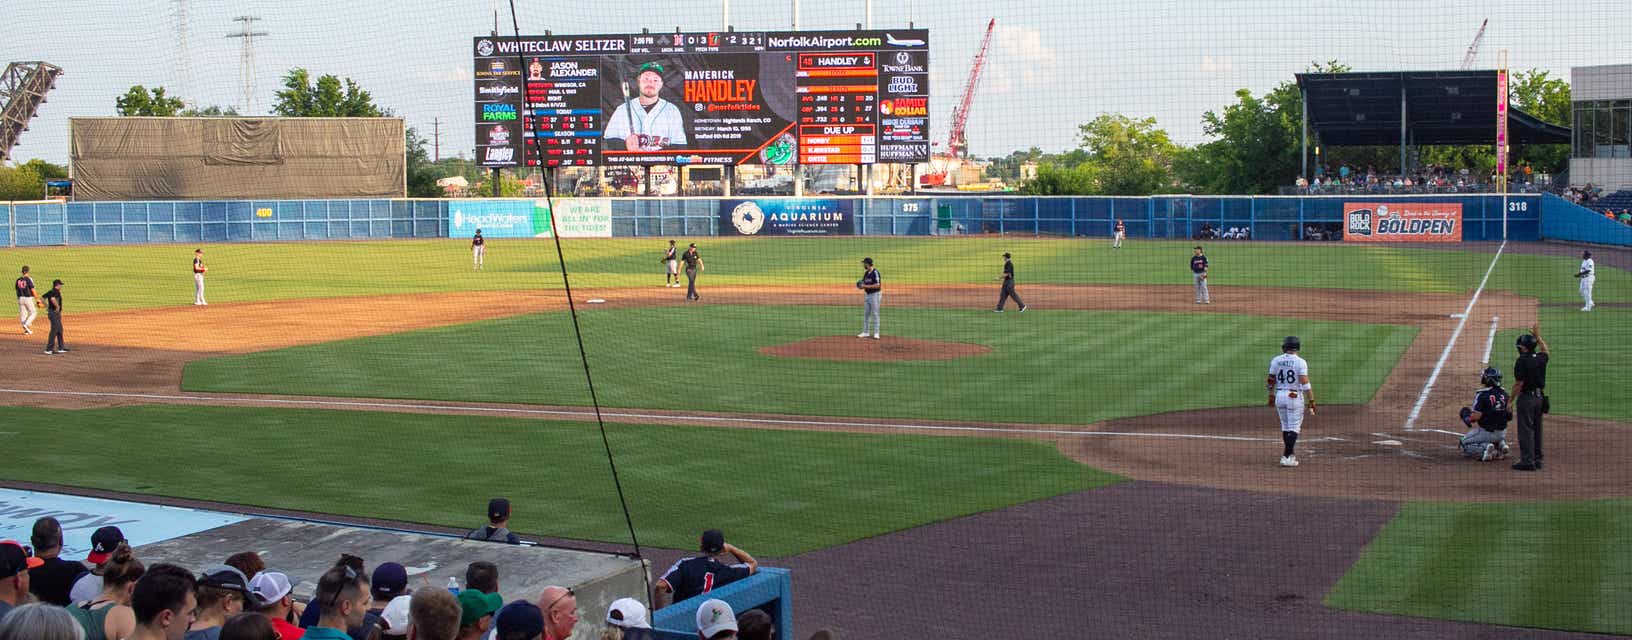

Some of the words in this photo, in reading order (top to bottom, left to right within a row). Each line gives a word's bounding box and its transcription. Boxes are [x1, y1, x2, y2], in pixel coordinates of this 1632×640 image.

[688, 36, 695, 45] 0
[700, 36, 707, 45] 3
[730, 35, 737, 44] 2
[768, 35, 881, 48] NorfolkAirport.com
[497, 40, 572, 52] WHITECLAW
[575, 39, 626, 51] SELTZER
[818, 57, 858, 65] HANDLEY
[684, 70, 735, 80] MAVERICK
[479, 86, 519, 95] Smithfield
[684, 80, 756, 102] HANDLEY
[888, 84, 918, 92] LIGHT
[893, 98, 927, 107] FAMILY
[483, 104, 517, 112] ROYAL
[707, 104, 761, 112] @norfolktides
[894, 106, 927, 115] DOLLAR
[483, 112, 517, 120] FARMS
[485, 146, 514, 161] Langley
[902, 203, 918, 212] 375
[1508, 202, 1527, 212] 318
[463, 212, 528, 224] HeadWaters
[770, 212, 843, 221] AQUARIUM
[1350, 214, 1369, 223] BOLD
[1350, 222, 1370, 230] ROCK
[1376, 218, 1455, 235] BOLDPEN
[1277, 369, 1296, 384] 48
[703, 571, 714, 593] 1
